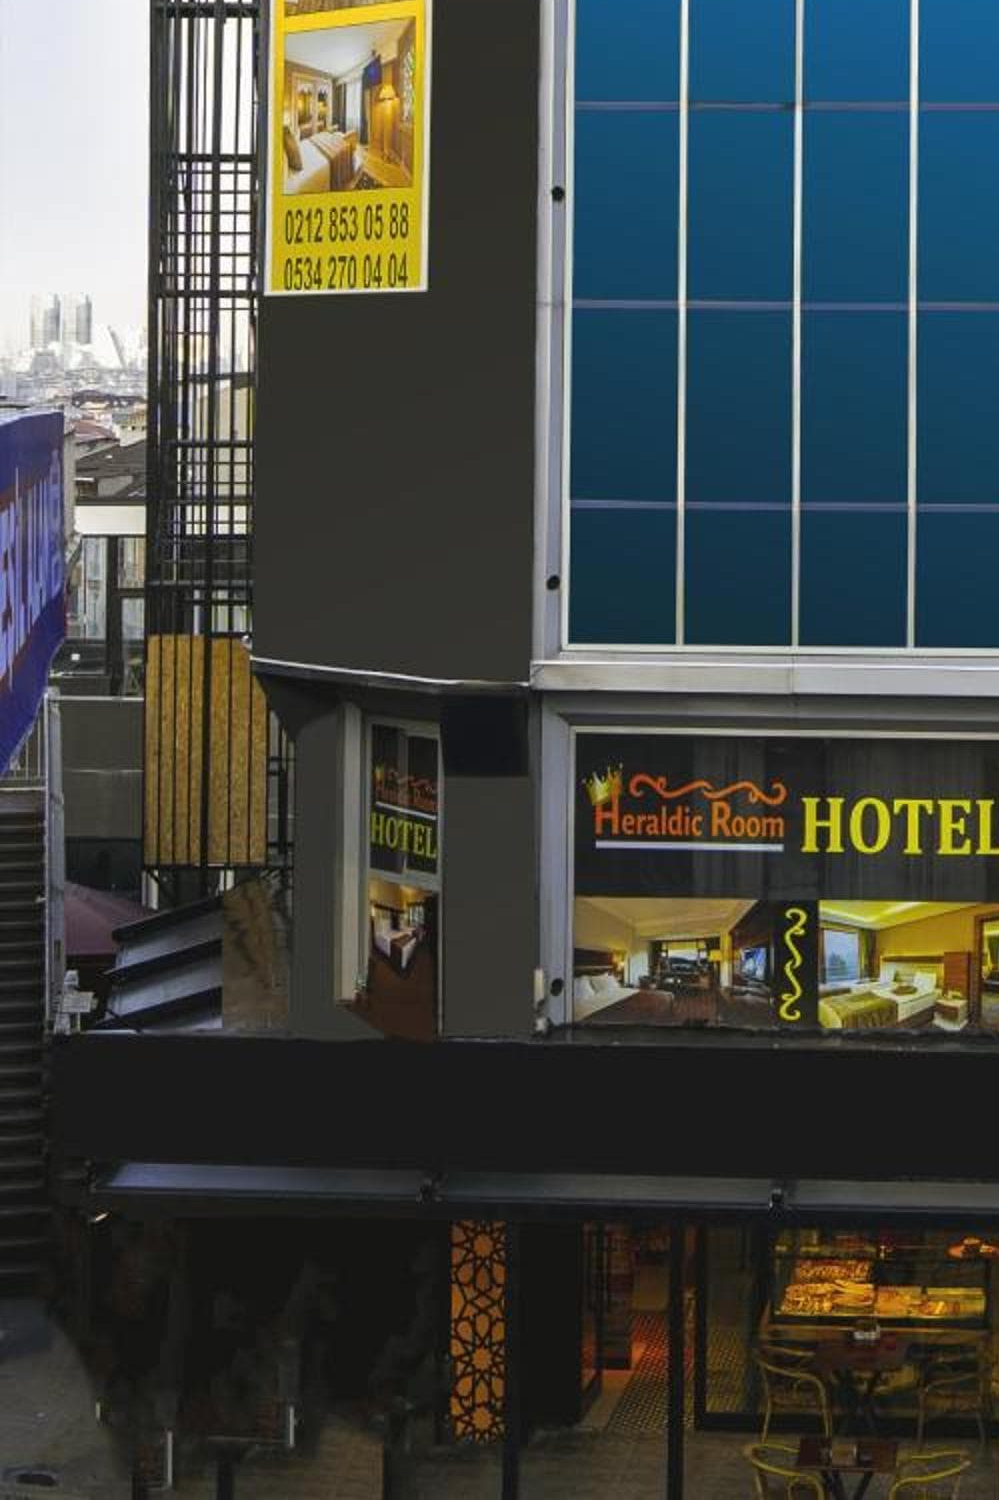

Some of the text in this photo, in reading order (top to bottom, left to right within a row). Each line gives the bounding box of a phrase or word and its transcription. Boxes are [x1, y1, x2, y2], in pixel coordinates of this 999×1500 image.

[285, 201, 409, 245] 0212 853 05 88
[284, 250, 409, 291] 0534 270 04 04
[594, 784, 702, 837] Heraldic
[711, 799, 785, 838] Room
[370, 811, 437, 858] HOTEL
